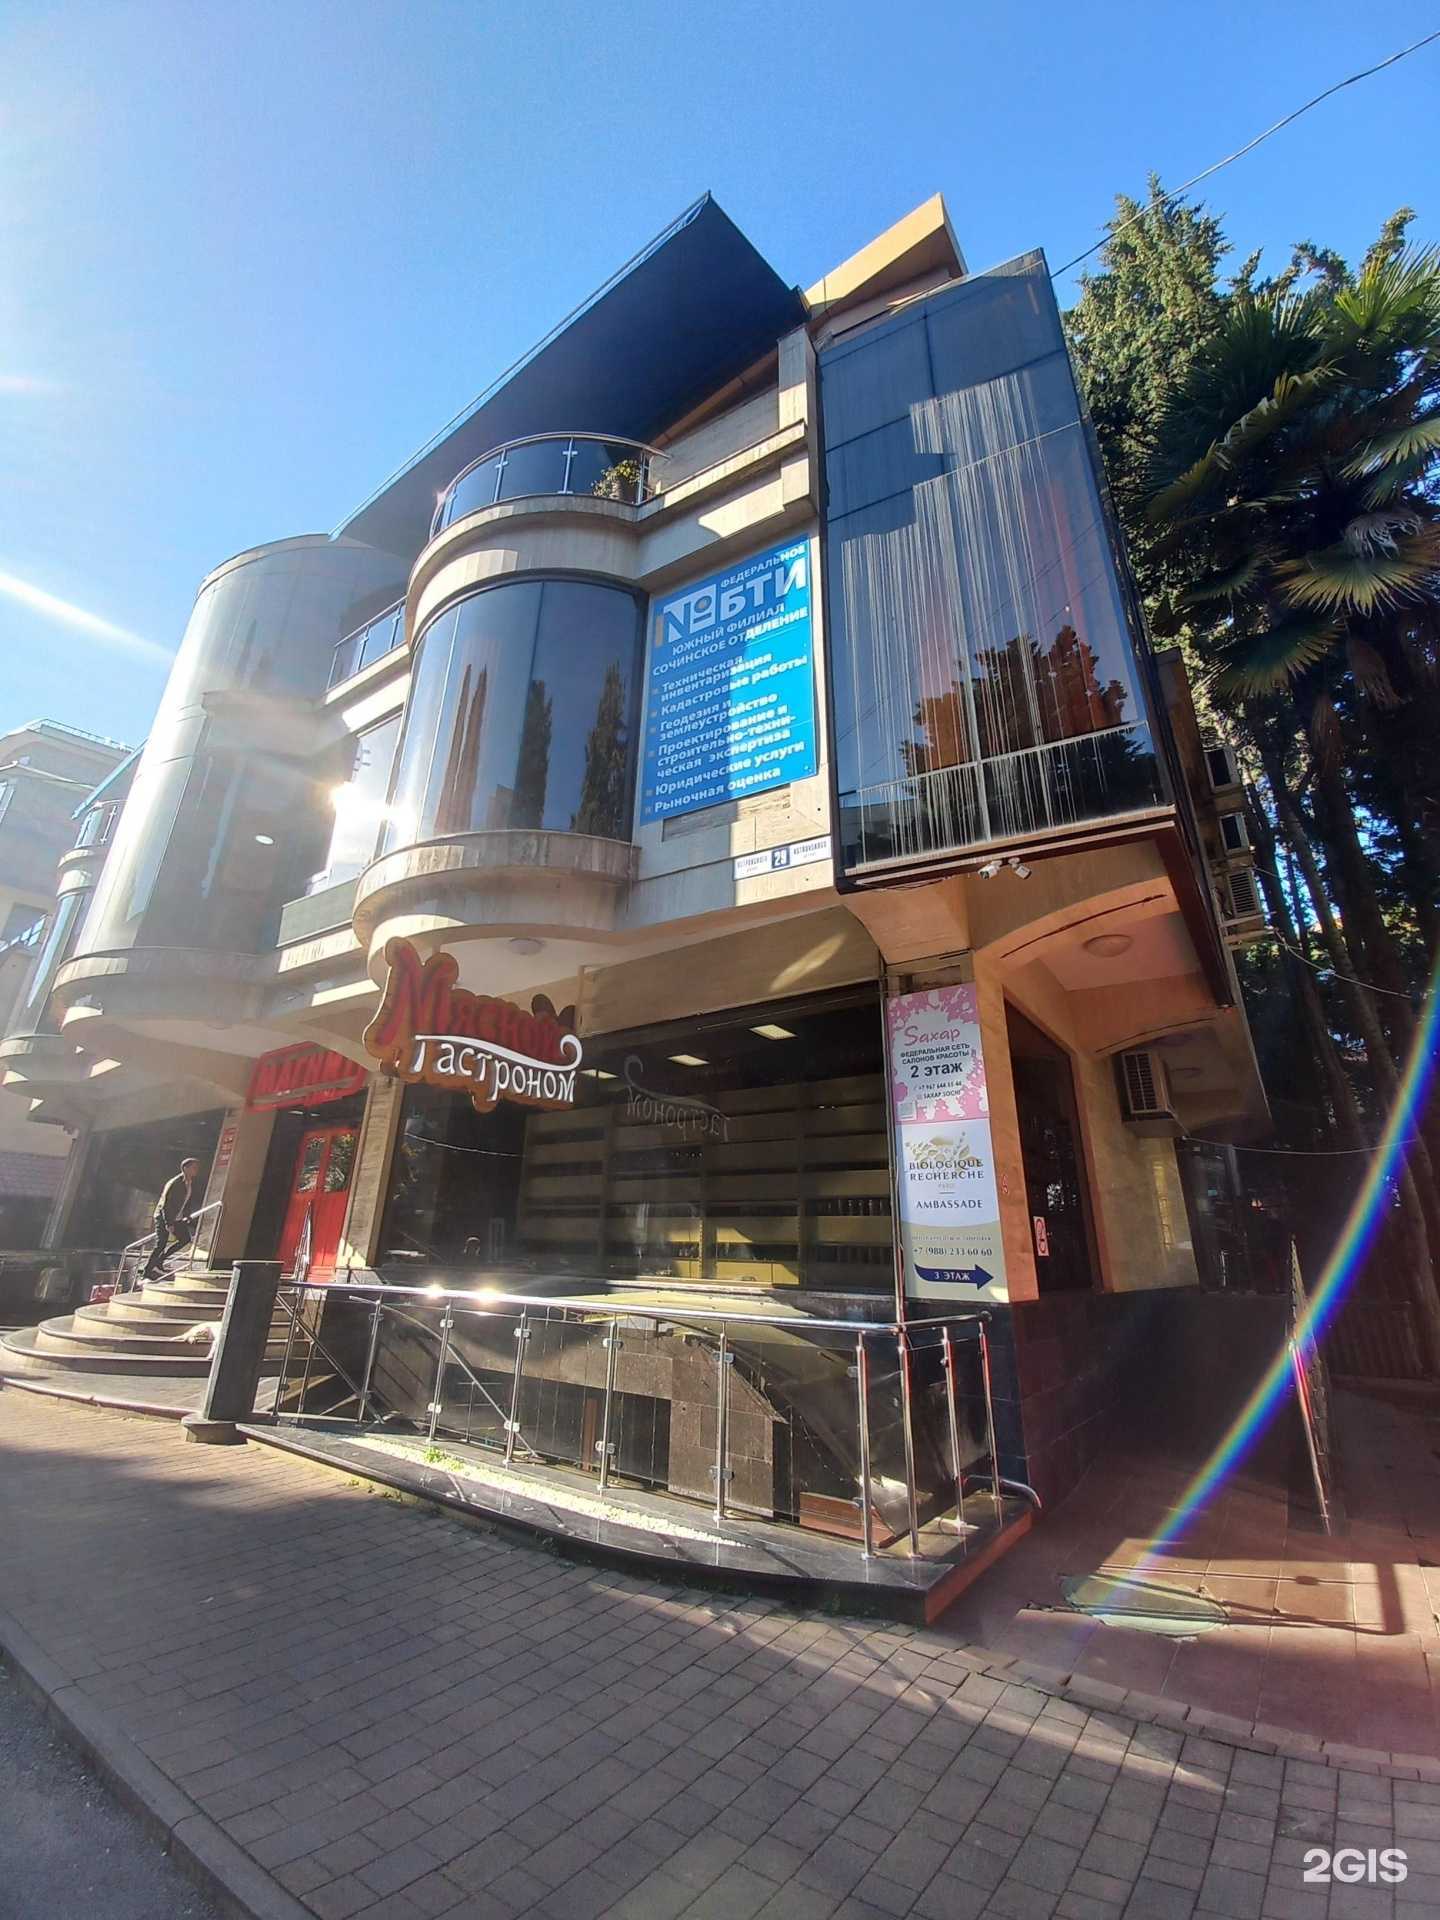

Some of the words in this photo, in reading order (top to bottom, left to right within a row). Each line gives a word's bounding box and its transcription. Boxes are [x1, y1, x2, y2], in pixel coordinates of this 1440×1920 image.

[720, 545, 805, 588] ФЕДЕРАЛЬНОЕ
[720, 557, 806, 621] БТИ
[653, 640, 726, 676] СОЧИНСКОЕ
[728, 606, 808, 645] ОТДЕЛЕНИЕ
[672, 626, 724, 656] ЮЖНЫЙ
[727, 603, 785, 633] ФИЛИАЛ
[661, 653, 773, 702] инвентаризация
[661, 677, 750, 716] Кадастровые
[752, 656, 808, 685] работы
[663, 655, 743, 692] Техническая
[658, 708, 775, 756] Проектирование
[777, 704, 788, 716] и
[659, 693, 778, 741] землеустройство
[660, 704, 719, 732] Геодезия
[722, 700, 732, 710] и
[655, 759, 751, 796] Юридические
[754, 741, 805, 767] услуги
[657, 758, 702, 778] ческая
[709, 728, 790, 762] экспертиза
[654, 784, 724, 812] Рыночная
[728, 767, 781, 790] оценка
[415, 1034, 582, 1103] Гастроном
[900, 1046, 950, 1058] ФЕДЕРАЛЬНАЯ
[902, 1055, 935, 1064] САЛОНОВ
[936, 1051, 969, 1060] КРАСОТЫ
[910, 1065, 919, 1078] 2
[924, 1063, 963, 1076] этаж
[909, 1159, 984, 1170] BIOLOGIQUE
[910, 1170, 984, 1180] RECHERCHE
[916, 1200, 984, 1209] AMBASSADE
[934, 1271, 940, 1280] 3
[943, 1272, 970, 1281] ЭТАЖ
